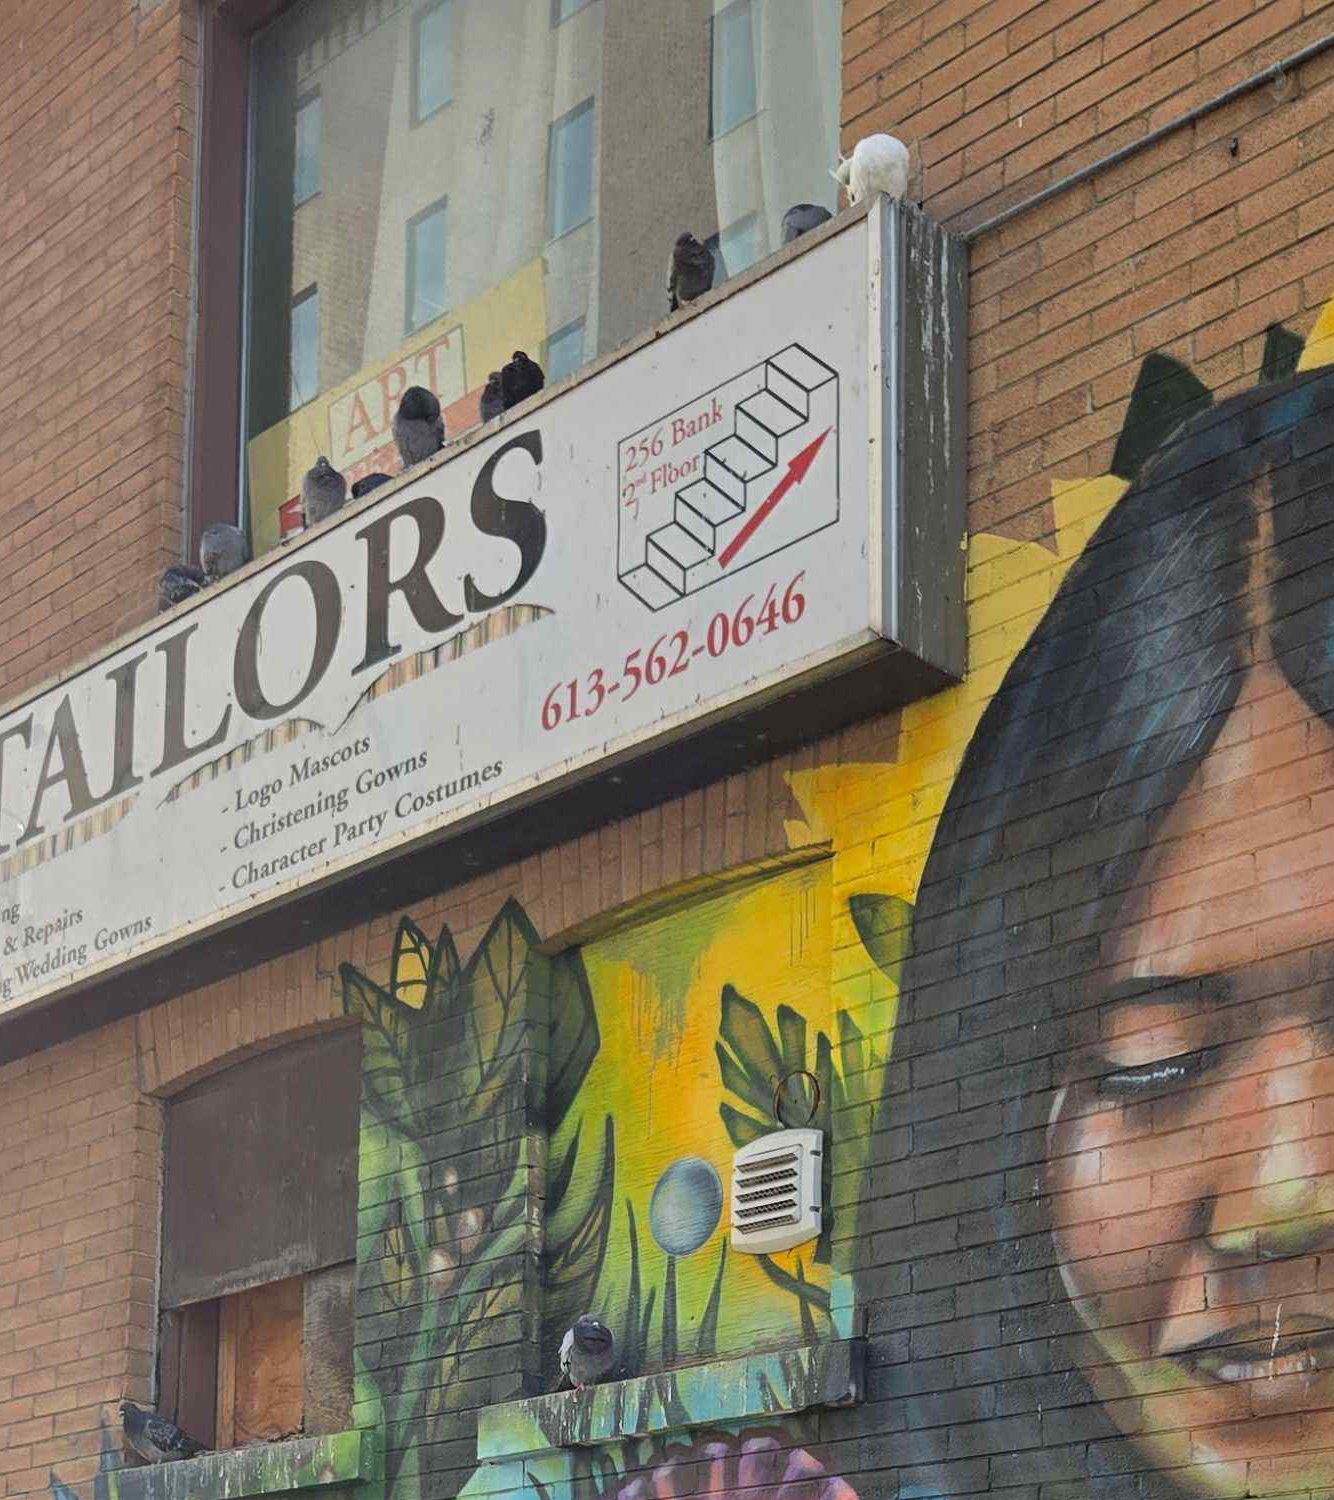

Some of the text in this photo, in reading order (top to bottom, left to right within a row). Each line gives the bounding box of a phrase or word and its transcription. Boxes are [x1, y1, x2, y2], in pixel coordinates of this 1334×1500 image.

[345, 336, 450, 454] ART
[625, 398, 724, 473] 256 Bank
[650, 453, 701, 494] Floor
[541, 569, 807, 731] 613-562-0646
[233, 750, 428, 850] Christening Gowns
[235, 735, 371, 812] Logo Mascots
[231, 759, 503, 889] Character Party Costumes
[2, 936, 18, 956] &
[22, 908, 84, 949] Repairs
[15, 941, 88, 986] Wedding
[94, 915, 153, 951] Gowns
